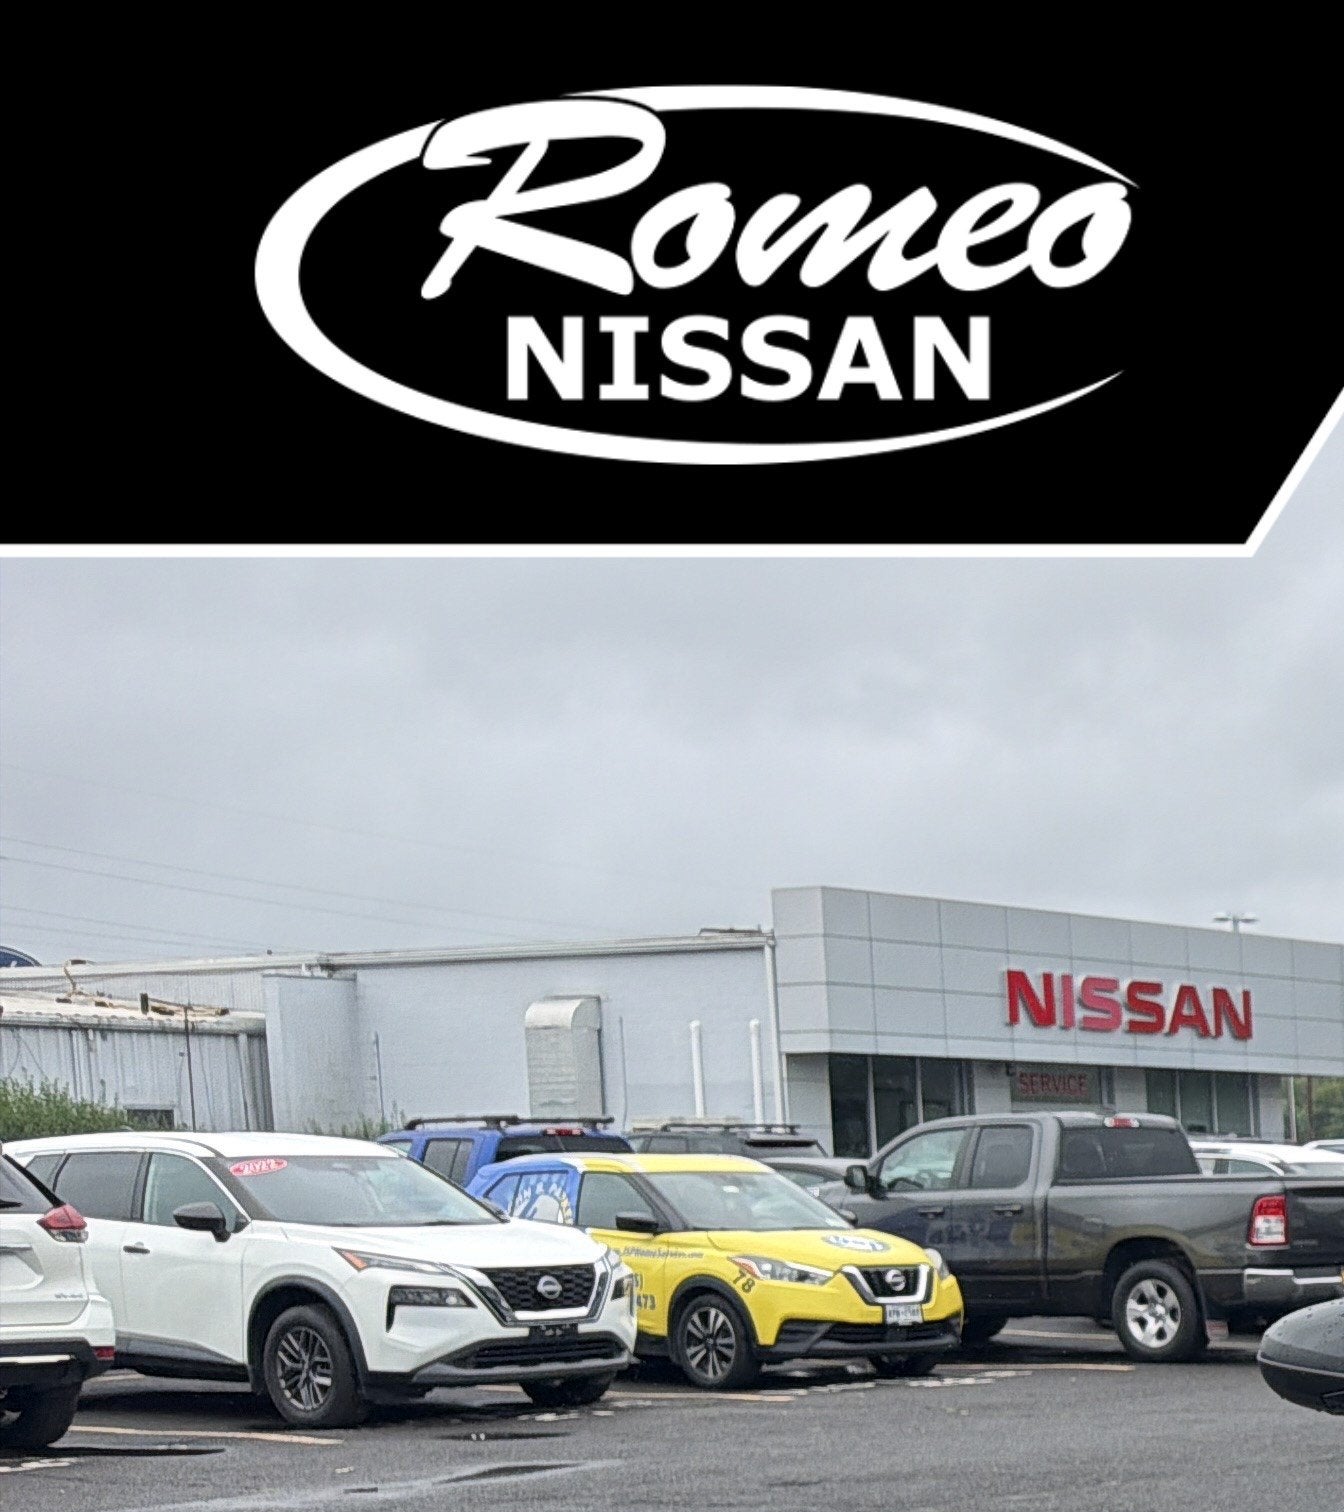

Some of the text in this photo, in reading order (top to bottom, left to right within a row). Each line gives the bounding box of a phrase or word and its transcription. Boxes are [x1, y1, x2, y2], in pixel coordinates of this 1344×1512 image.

[1007, 970, 1253, 1040] NISSAN
[1018, 1072, 1088, 1097] SERVICE
[733, 1268, 756, 1294] 78
